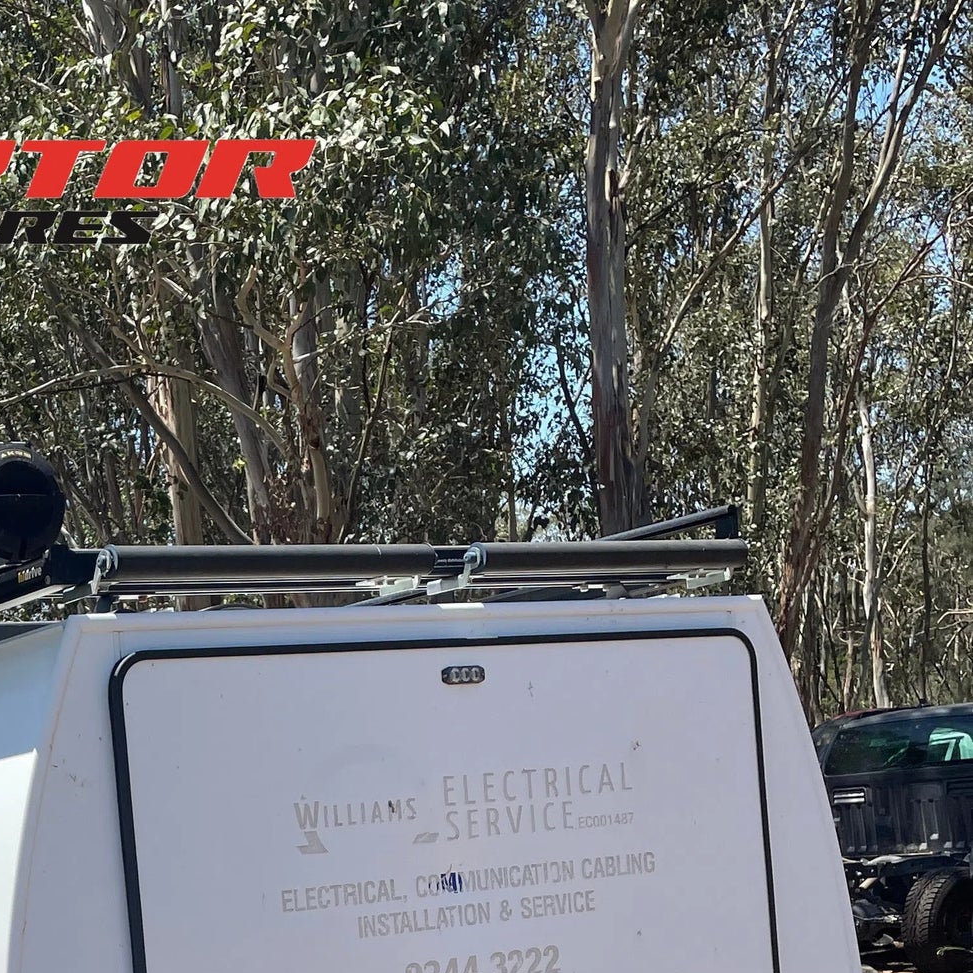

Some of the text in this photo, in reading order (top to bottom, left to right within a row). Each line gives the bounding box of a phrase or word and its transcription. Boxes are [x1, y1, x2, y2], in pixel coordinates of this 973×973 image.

[442, 762, 633, 807] ELECTRICAL
[293, 797, 417, 830] WILLIAMS
[445, 801, 574, 842] SERVICE
[581, 852, 656, 880] CABLING
[358, 889, 596, 939] INSTALLATION & SERVICE
